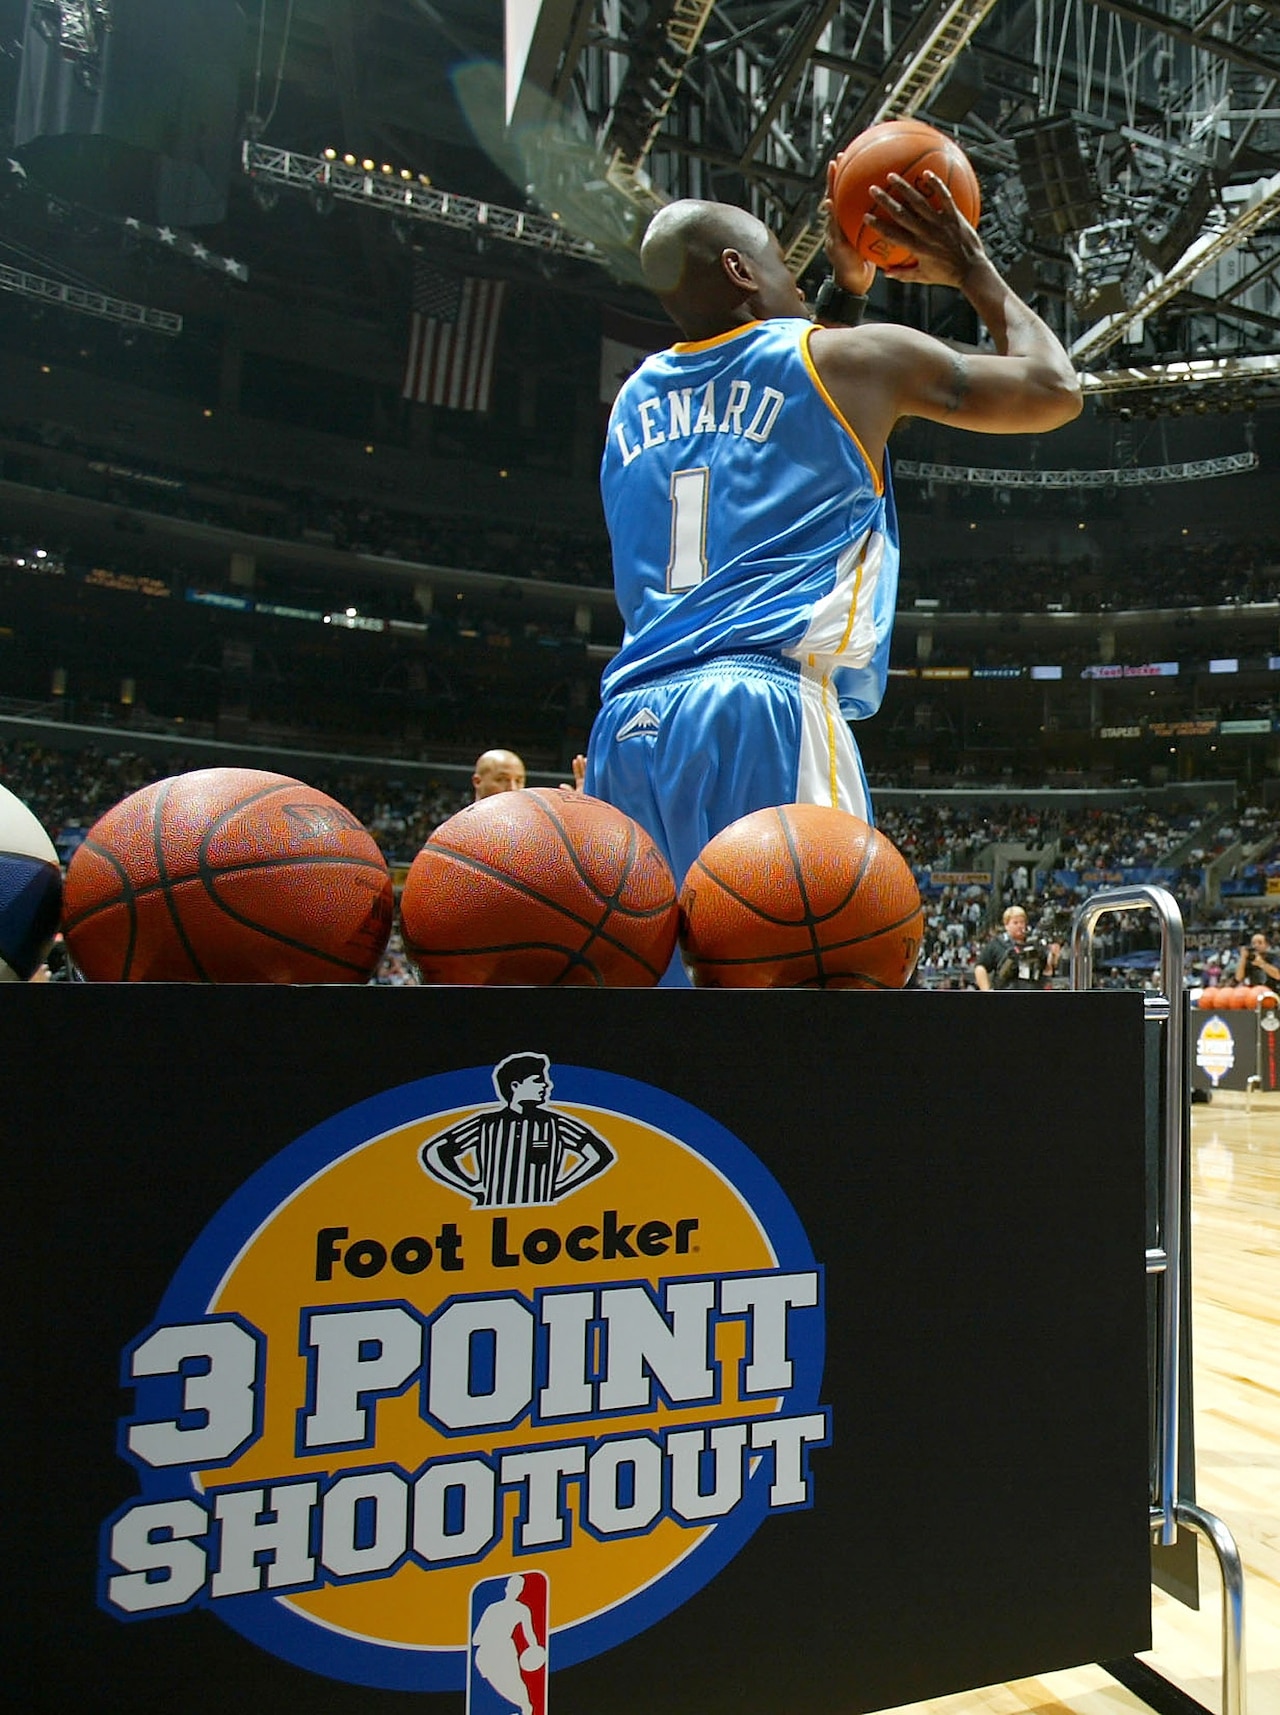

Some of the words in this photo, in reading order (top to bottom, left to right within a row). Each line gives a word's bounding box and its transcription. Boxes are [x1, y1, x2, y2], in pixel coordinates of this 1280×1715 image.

[615, 379, 785, 467] LENARD
[666, 466, 710, 594] 1
[1100, 726, 1141, 739] STAPLES
[315, 1223, 464, 1282] Foot
[491, 1210, 699, 1268] Locker
[126, 1319, 259, 1468] 3
[301, 1271, 820, 1447] POINT
[106, 1413, 826, 1613] SHOOTOUT
